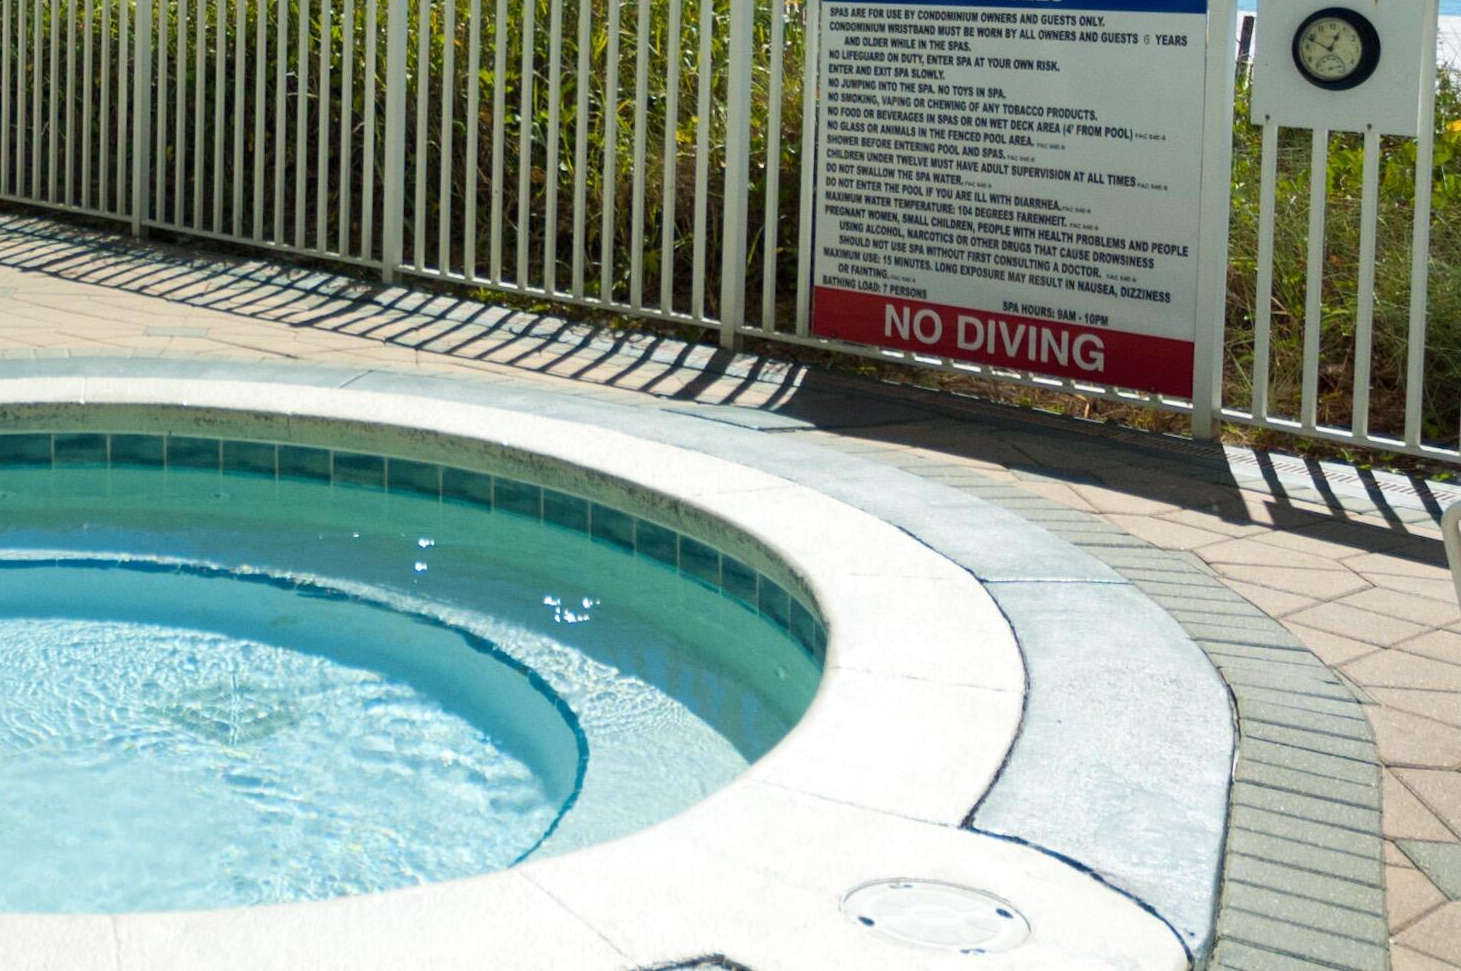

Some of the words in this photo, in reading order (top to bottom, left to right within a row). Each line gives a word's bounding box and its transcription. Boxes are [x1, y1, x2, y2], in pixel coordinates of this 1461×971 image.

[829, 6, 848, 18] SPAS
[850, 7, 866, 18] ARE
[868, 7, 884, 19] FOR
[885, 8, 902, 20] USE
[903, 9, 915, 20] BY
[917, 9, 978, 22] CONDOMINIUM
[980, 12, 1017, 23] OWNERS
[1019, 13, 1038, 24] AND
[1040, 14, 1076, 26] GUESTS
[1078, 15, 1104, 27] ONLY.
[829, 20, 885, 33] CONDOMINIUM
[887, 23, 935, 35] WRISTBAND
[937, 25, 961, 36] MUST
[963, 26, 974, 37] BE
[976, 27, 1002, 38] WORN
[1004, 27, 1017, 39] BY
[1018, 28, 1035, 39] ALL
[1037, 29, 1076, 41] OWNERS
[1078, 31, 1098, 42] AND
[1100, 31, 1138, 44] GUESTS
[1143, 33, 1150, 45] 6
[1155, 34, 1187, 46] YEARS
[844, 36, 860, 46] AND
[862, 36, 888, 47] OLDER
[890, 37, 915, 49] WHILE
[917, 39, 926, 49] IN
[928, 39, 945, 50] THE
[947, 40, 971, 51] SPAS.
[828, 49, 839, 60] NO
[841, 50, 885, 62] LIFEGUARD
[886, 52, 898, 63] ON
[926, 54, 953, 65] ENTER
[955, 55, 971, 66] SPA
[973, 56, 985, 67] AT
[987, 57, 1011, 69] YOUR
[1013, 58, 1033, 69] OWN
[828, 77, 839, 88] NO
[840, 78, 876, 90] JUMPING
[878, 80, 897, 91] INTO
[899, 81, 915, 93] THE
[937, 84, 949, 94] NO
[952, 85, 973, 96] TOYS
[975, 87, 985, 97] IN
[827, 91, 839, 102] NO
[840, 92, 879, 106] SMOKING,
[881, 95, 911, 107] VAPING
[913, 97, 925, 108] OR
[927, 98, 966, 111] CHEWING
[968, 101, 980, 112] OF
[982, 102, 1000, 113] ANY
[1002, 103, 1044, 116] TOBACCO
[1046, 106, 1097, 121] PRODUCTS.
[827, 105, 838, 116] NO
[840, 106, 861, 118] FOOD
[862, 108, 874, 119] OR
[876, 109, 924, 123] BEVERAGES
[926, 113, 935, 124] IN
[937, 113, 958, 125] SPAS
[960, 115, 972, 126] OR
[974, 116, 987, 127] ON
[989, 117, 1008, 129] WET
[1010, 119, 1033, 131] DECK
[1036, 121, 1060, 133] AREA
[1076, 124, 1101, 136] FROM
[1104, 126, 1133, 141] POOL)
[827, 119, 838, 130] NO
[839, 120, 865, 132] GLASS
[866, 122, 878, 133] OR
[879, 124, 915, 137] ANIMALS
[917, 126, 927, 137] IN
[928, 127, 945, 139] THE
[947, 129, 981, 142] FENCED
[983, 132, 1006, 144] POOL
[1008, 134, 1035, 146] AREA.
[826, 147, 864, 161] CHILDREN
[866, 151, 894, 164] UNDER
[896, 154, 928, 167] TWELVE
[930, 157, 954, 169] MUST
[955, 159, 978, 172] HAVE
[980, 162, 1009, 174] ADULT
[1011, 164, 1071, 181] SUPERVISION
[1072, 170, 1084, 182] AT
[1087, 172, 1104, 184] ALL
[1107, 173, 1137, 187] TIMES
[825, 190, 862, 204] MAXIMUM
[863, 195, 891, 207] WATER
[893, 197, 955, 214] TEMPERATURE:
[957, 204, 972, 216] 104
[974, 206, 1014, 221] DEGREES
[1016, 211, 1066, 227] FARENHEIT.
[825, 204, 866, 219] PREGNANT
[867, 209, 899, 224] WOMEN,
[902, 213, 929, 226] SMALL
[930, 216, 975, 233] CHILDREN,
[977, 221, 1010, 236] PEOPLE
[1012, 226, 1035, 238] WITH
[1038, 228, 1073, 243] HEALTH
[1075, 233, 1125, 249] PROBLEMS
[1128, 239, 1148, 252] AND
[1151, 242, 1188, 257] PEOPLE
[839, 220, 863, 233] USING
[865, 223, 905, 239] ALCOHOL,
[906, 228, 954, 244] NARCOTICS
[955, 234, 968, 246] OR
[970, 236, 999, 249] OTHER
[1001, 239, 1031, 253] DRUGS
[1033, 243, 1057, 256] THAT
[1059, 247, 1090, 261] CAUSE
[1092, 250, 1154, 269] DROWSINESS
[838, 234, 870, 248] SHOULD
[872, 238, 889, 250] NOT
[890, 240, 906, 253] USE
[908, 243, 924, 255] SPA
[926, 245, 965, 260] WITHOUT
[967, 250, 991, 263] FIRST
[993, 253, 1050, 271] CONSULTING
[1052, 261, 1059, 272] A
[1061, 262, 1101, 278] DOCTOR.
[823, 246, 860, 261] MAXIMUM
[862, 251, 880, 264] USE:
[882, 254, 892, 265] 15
[893, 255, 932, 271] MINUTES.
[934, 261, 957, 274] LONG
[959, 264, 1005, 280] EXPOSURE
[1007, 271, 1026, 283] MAY
[1028, 273, 1063, 288] RESULT
[1065, 278, 1074, 290] IN
[1077, 280, 1117, 298] NAUSEA,
[1120, 286, 1170, 303] DIZZINESS
[837, 262, 849, 273] OR
[850, 264, 890, 279] FAINTING.
[822, 274, 855, 289] BATHING
[857, 279, 880, 292] LOAD:
[882, 283, 887, 293] 7
[889, 284, 927, 299] PERSONS
[1002, 300, 1018, 313] SPA
[1021, 303, 1054, 318] HOURS:
[1056, 308, 1076, 321] 9AM
[1084, 312, 1108, 326] 10PM
[885, 304, 942, 344] NO
[957, 315, 1104, 372] DIVING
